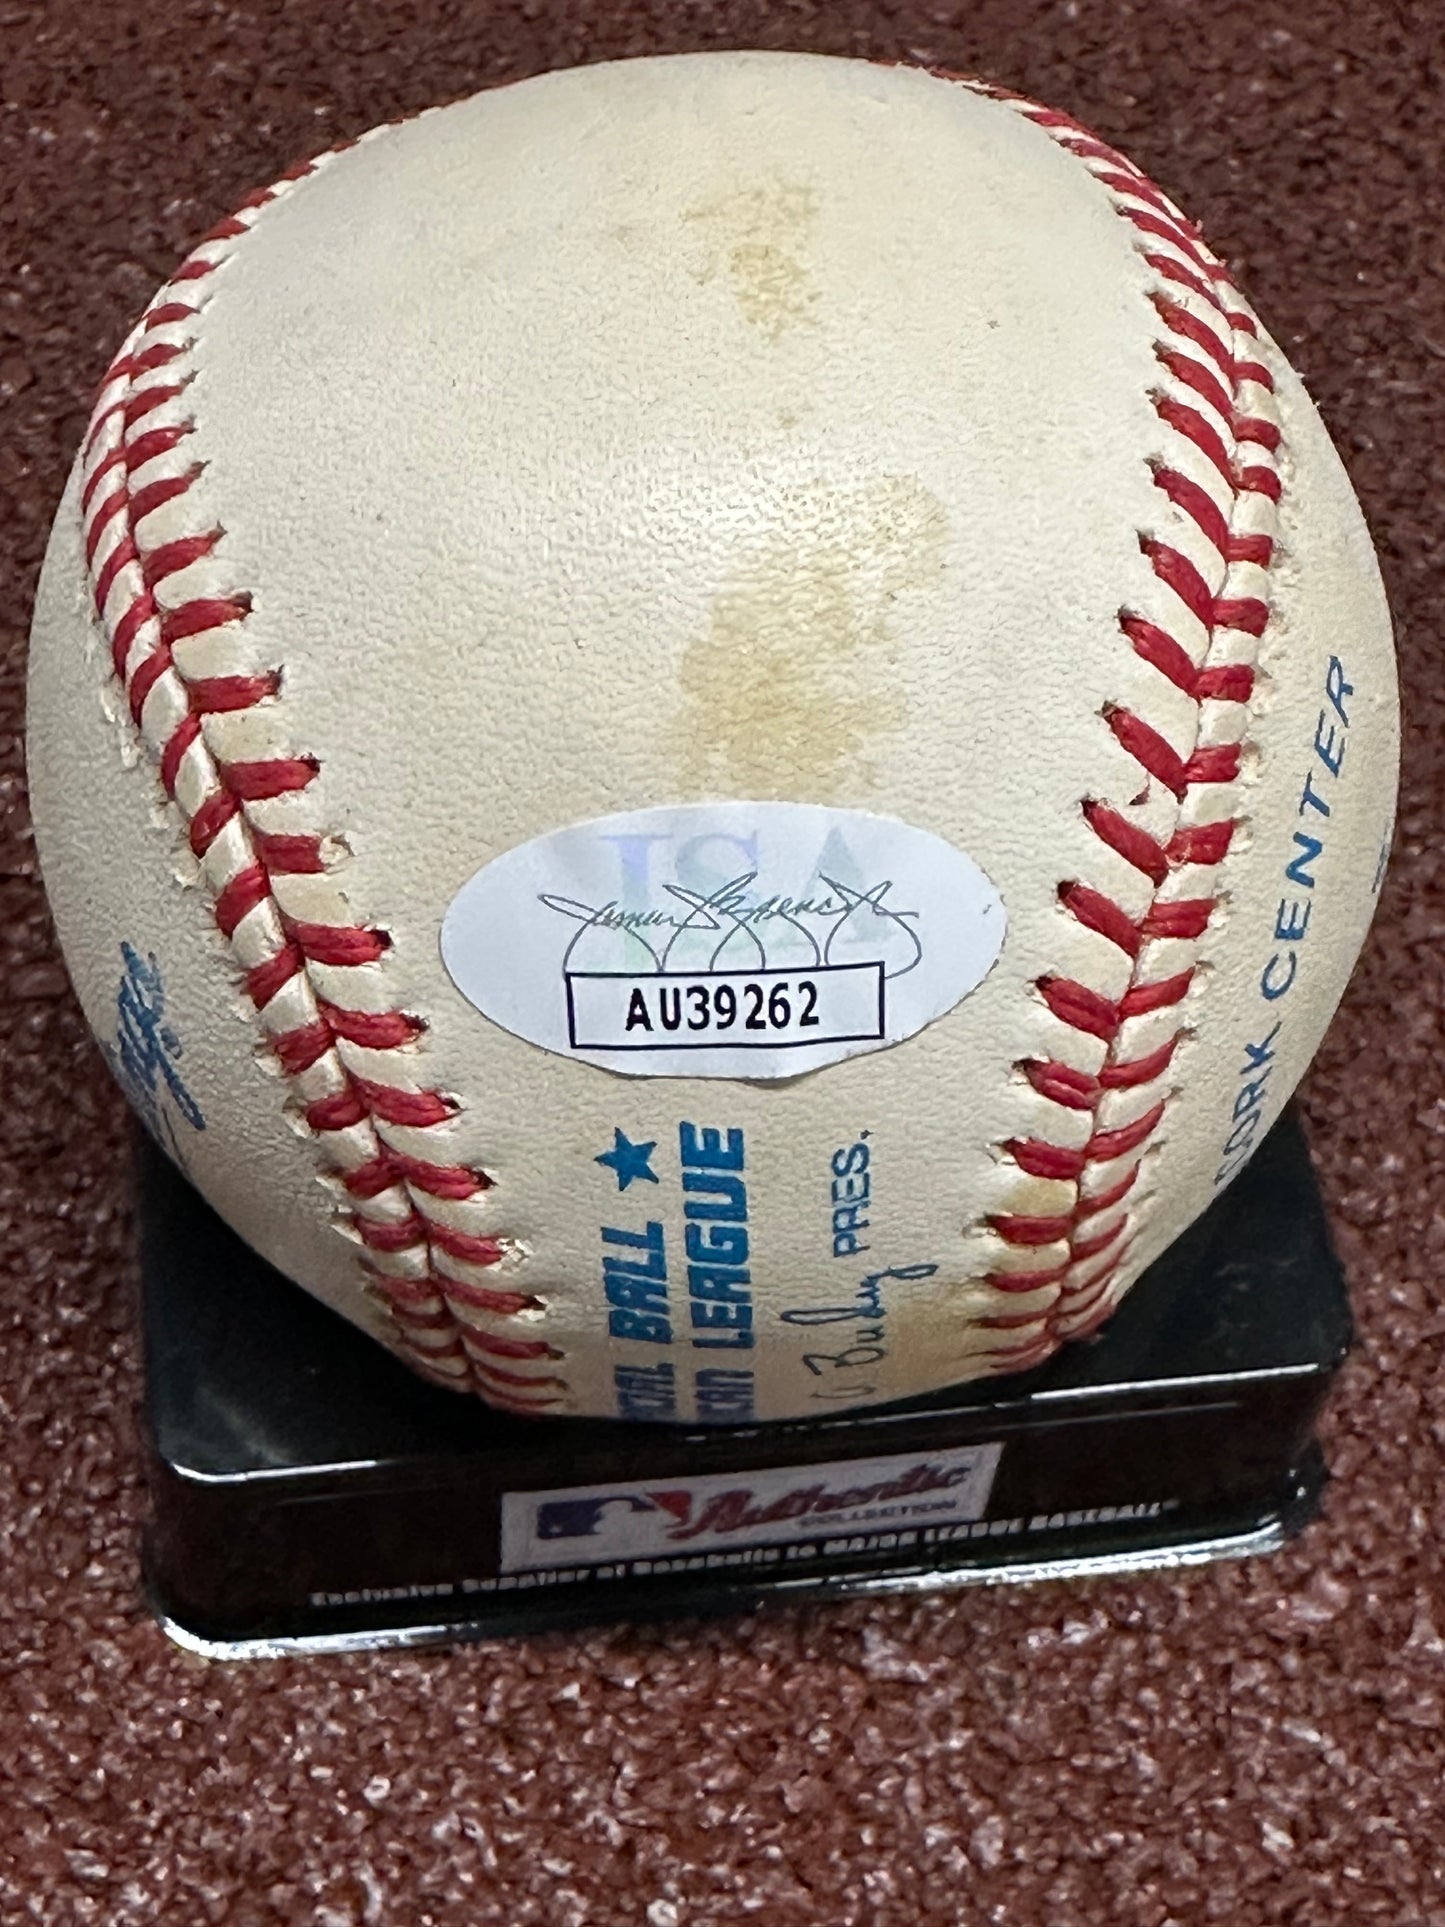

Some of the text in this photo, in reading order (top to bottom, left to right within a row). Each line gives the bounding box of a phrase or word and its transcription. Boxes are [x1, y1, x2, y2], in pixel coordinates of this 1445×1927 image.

[1261, 655, 1355, 1001] CENTER
[624, 979, 820, 1032] AU39262
[678, 1119, 755, 1349] LEAGUE
[830, 1129, 875, 1258] PRES.
[600, 1220, 674, 1344] BALL
